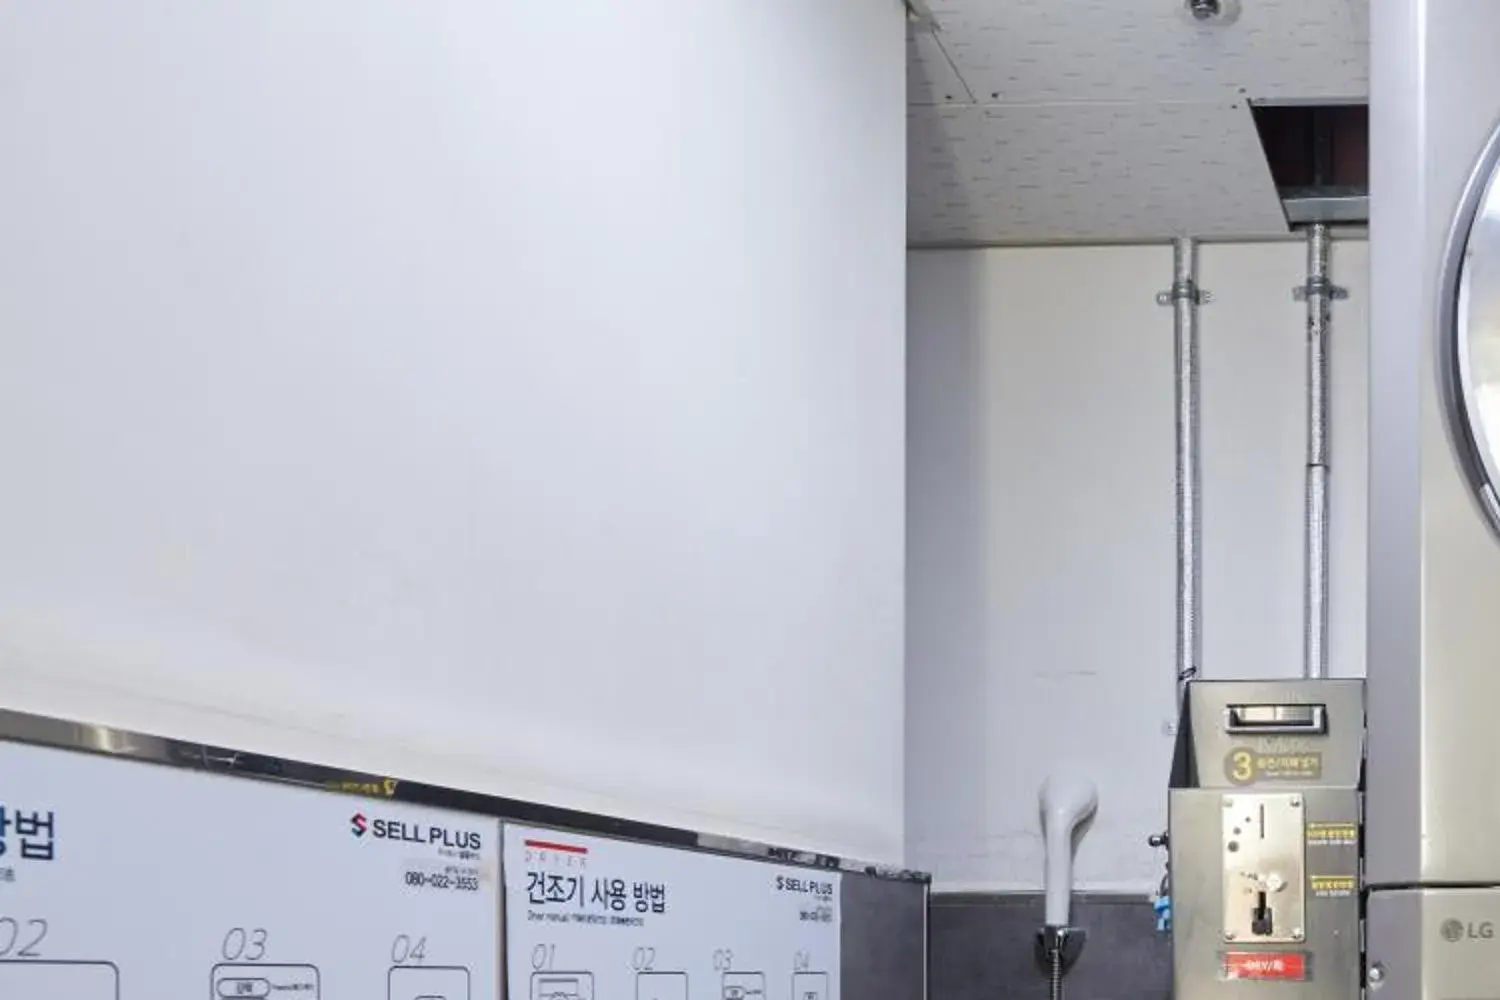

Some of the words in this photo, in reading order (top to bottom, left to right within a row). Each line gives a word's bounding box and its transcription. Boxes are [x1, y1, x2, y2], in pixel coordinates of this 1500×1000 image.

[1233, 752, 1252, 781] 3
[372, 819, 426, 843] SELL
[430, 826, 481, 849] PLUS
[527, 871, 585, 909] 건조기
[591, 877, 627, 912] 사용
[633, 881, 666, 913] 방법
[785, 877, 808, 892] SELL
[222, 928, 268, 961] 03
[1467, 922, 1494, 939] LG
[391, 934, 426, 963] 04
[531, 943, 555, 970] 01
